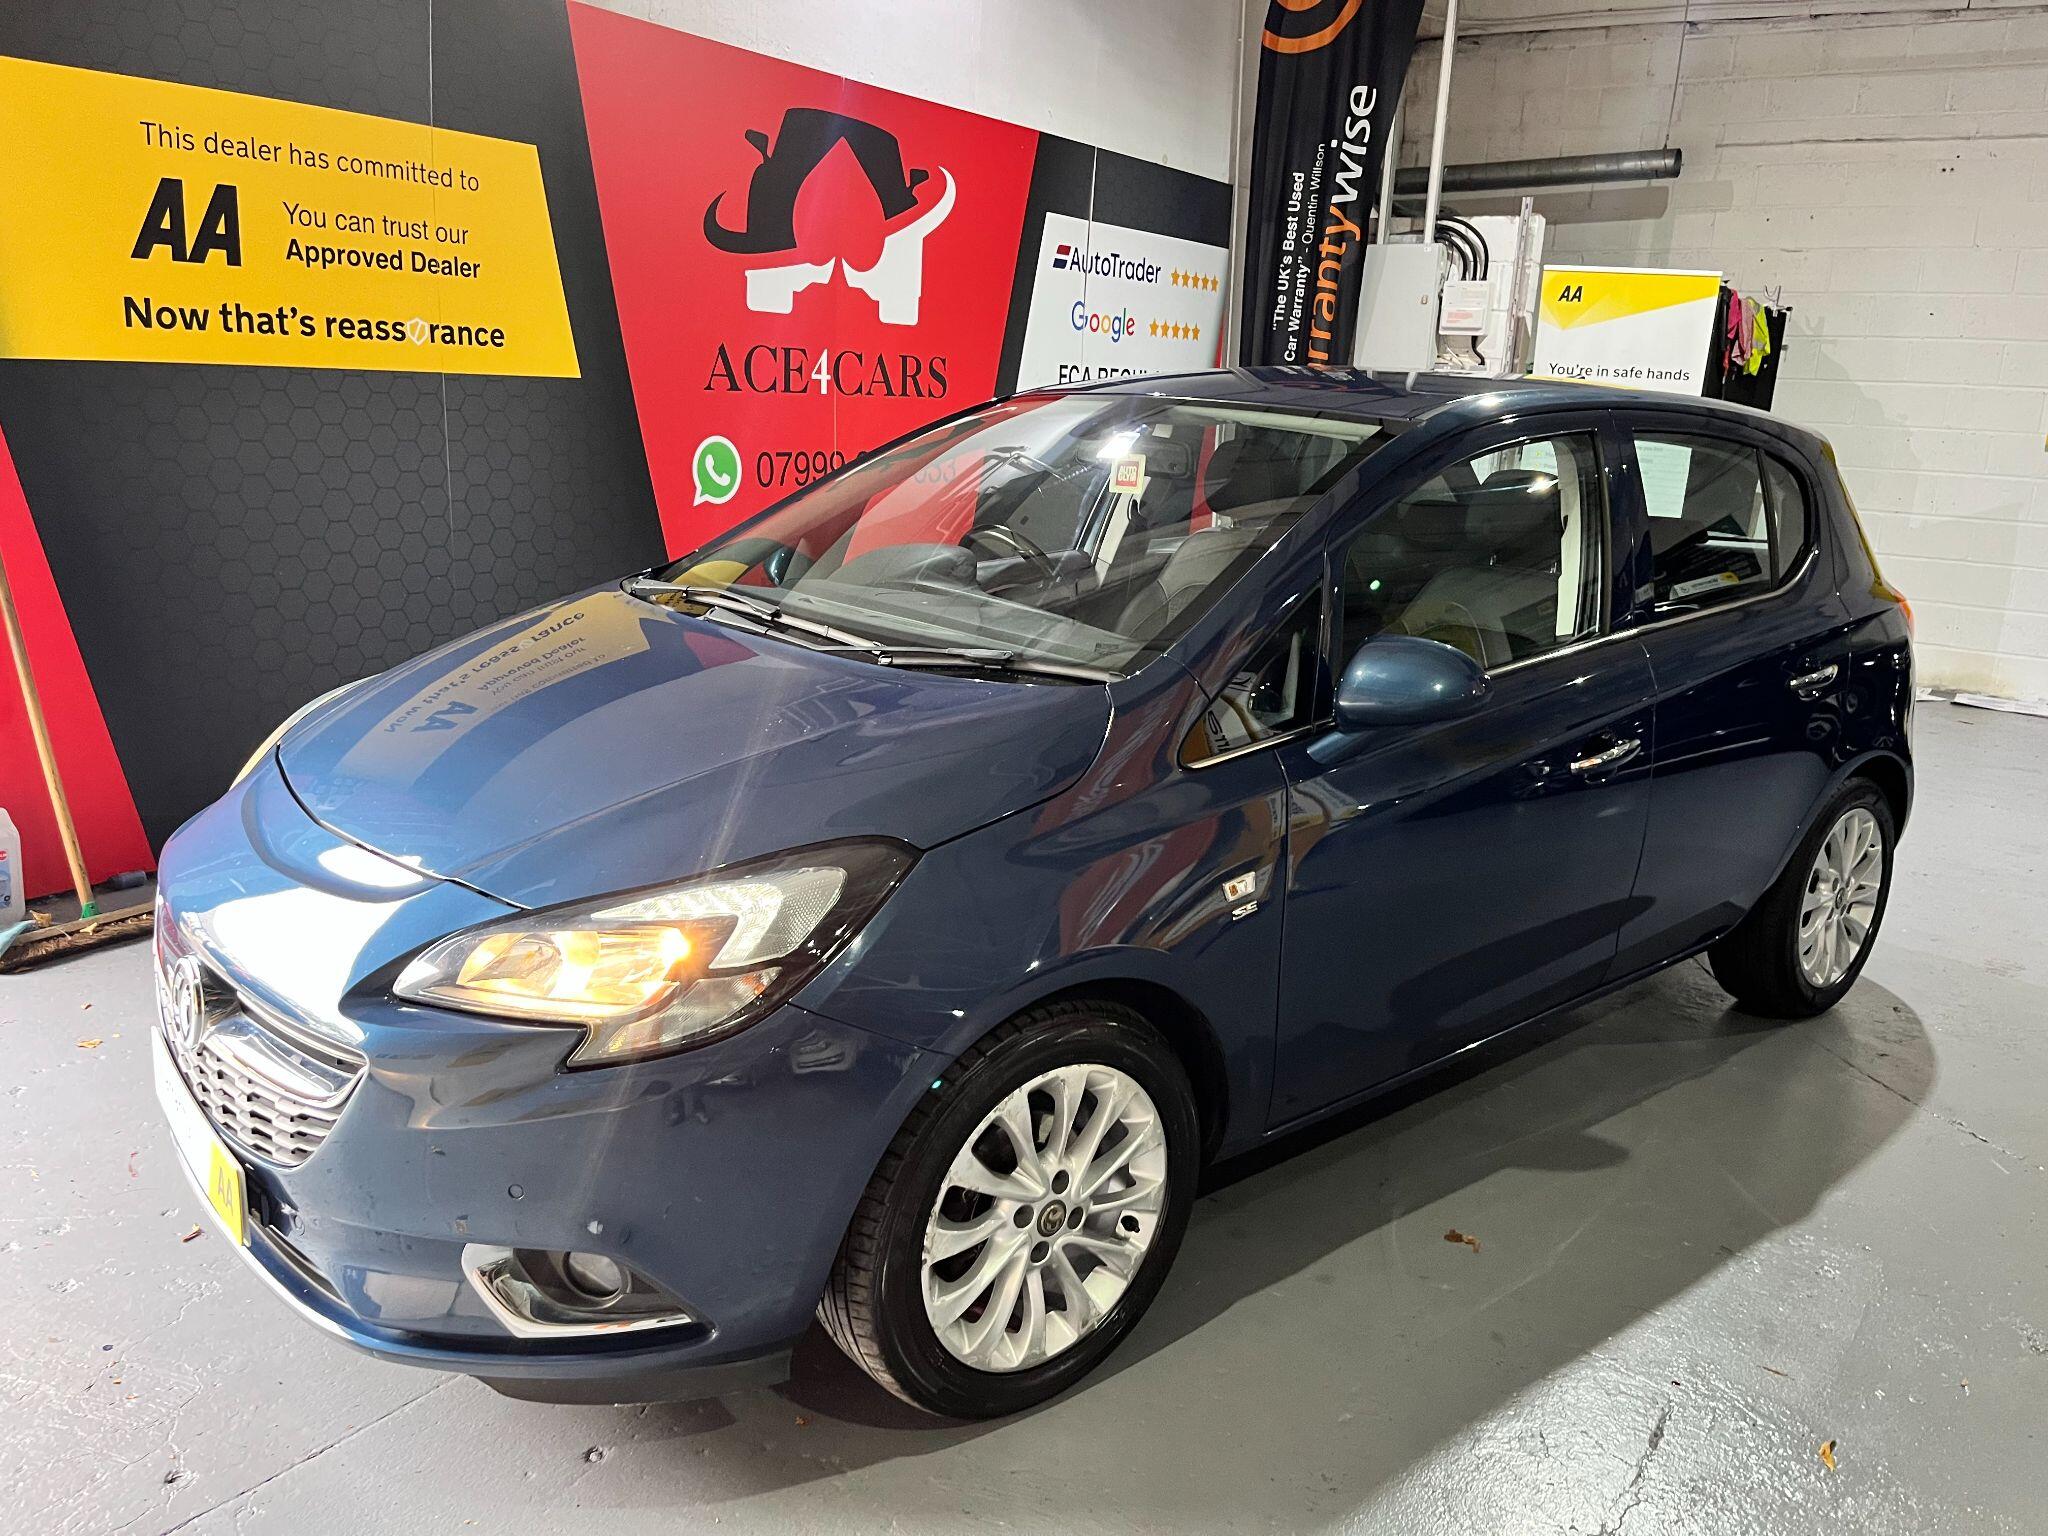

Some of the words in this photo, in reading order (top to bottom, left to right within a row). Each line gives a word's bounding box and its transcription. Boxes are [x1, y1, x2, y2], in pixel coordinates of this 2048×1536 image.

[139, 121, 195, 151] This
[203, 131, 281, 163] dealer
[289, 142, 330, 170] has
[336, 155, 454, 188] committed
[459, 170, 480, 192] to
[1287, 172, 1305, 211] Used
[130, 177, 242, 267] AA
[282, 201, 327, 229] You
[335, 213, 375, 234] can
[382, 215, 429, 241] trust
[435, 226, 469, 246] our
[1282, 216, 1299, 251] Best
[1307, 85, 1377, 369] rrantywise
[285, 238, 403, 271] Approved
[411, 252, 481, 279] Dealer
[1070, 247, 1162, 284] AutoTrader
[1277, 255, 1293, 290] UK's
[1284, 335, 1298, 361] Car
[1301, 194, 1319, 244] Quentin
[1310, 143, 1325, 190] Willson
[1557, 285, 1583, 302] AA
[123, 296, 209, 331] Now
[218, 302, 316, 337] that's
[1071, 300, 1135, 344] Google
[703, 342, 948, 399] ACE4CARS
[1549, 362, 1593, 377] You're
[1596, 365, 1609, 377] in
[1612, 366, 1643, 379] safe
[1646, 368, 1691, 381] hands
